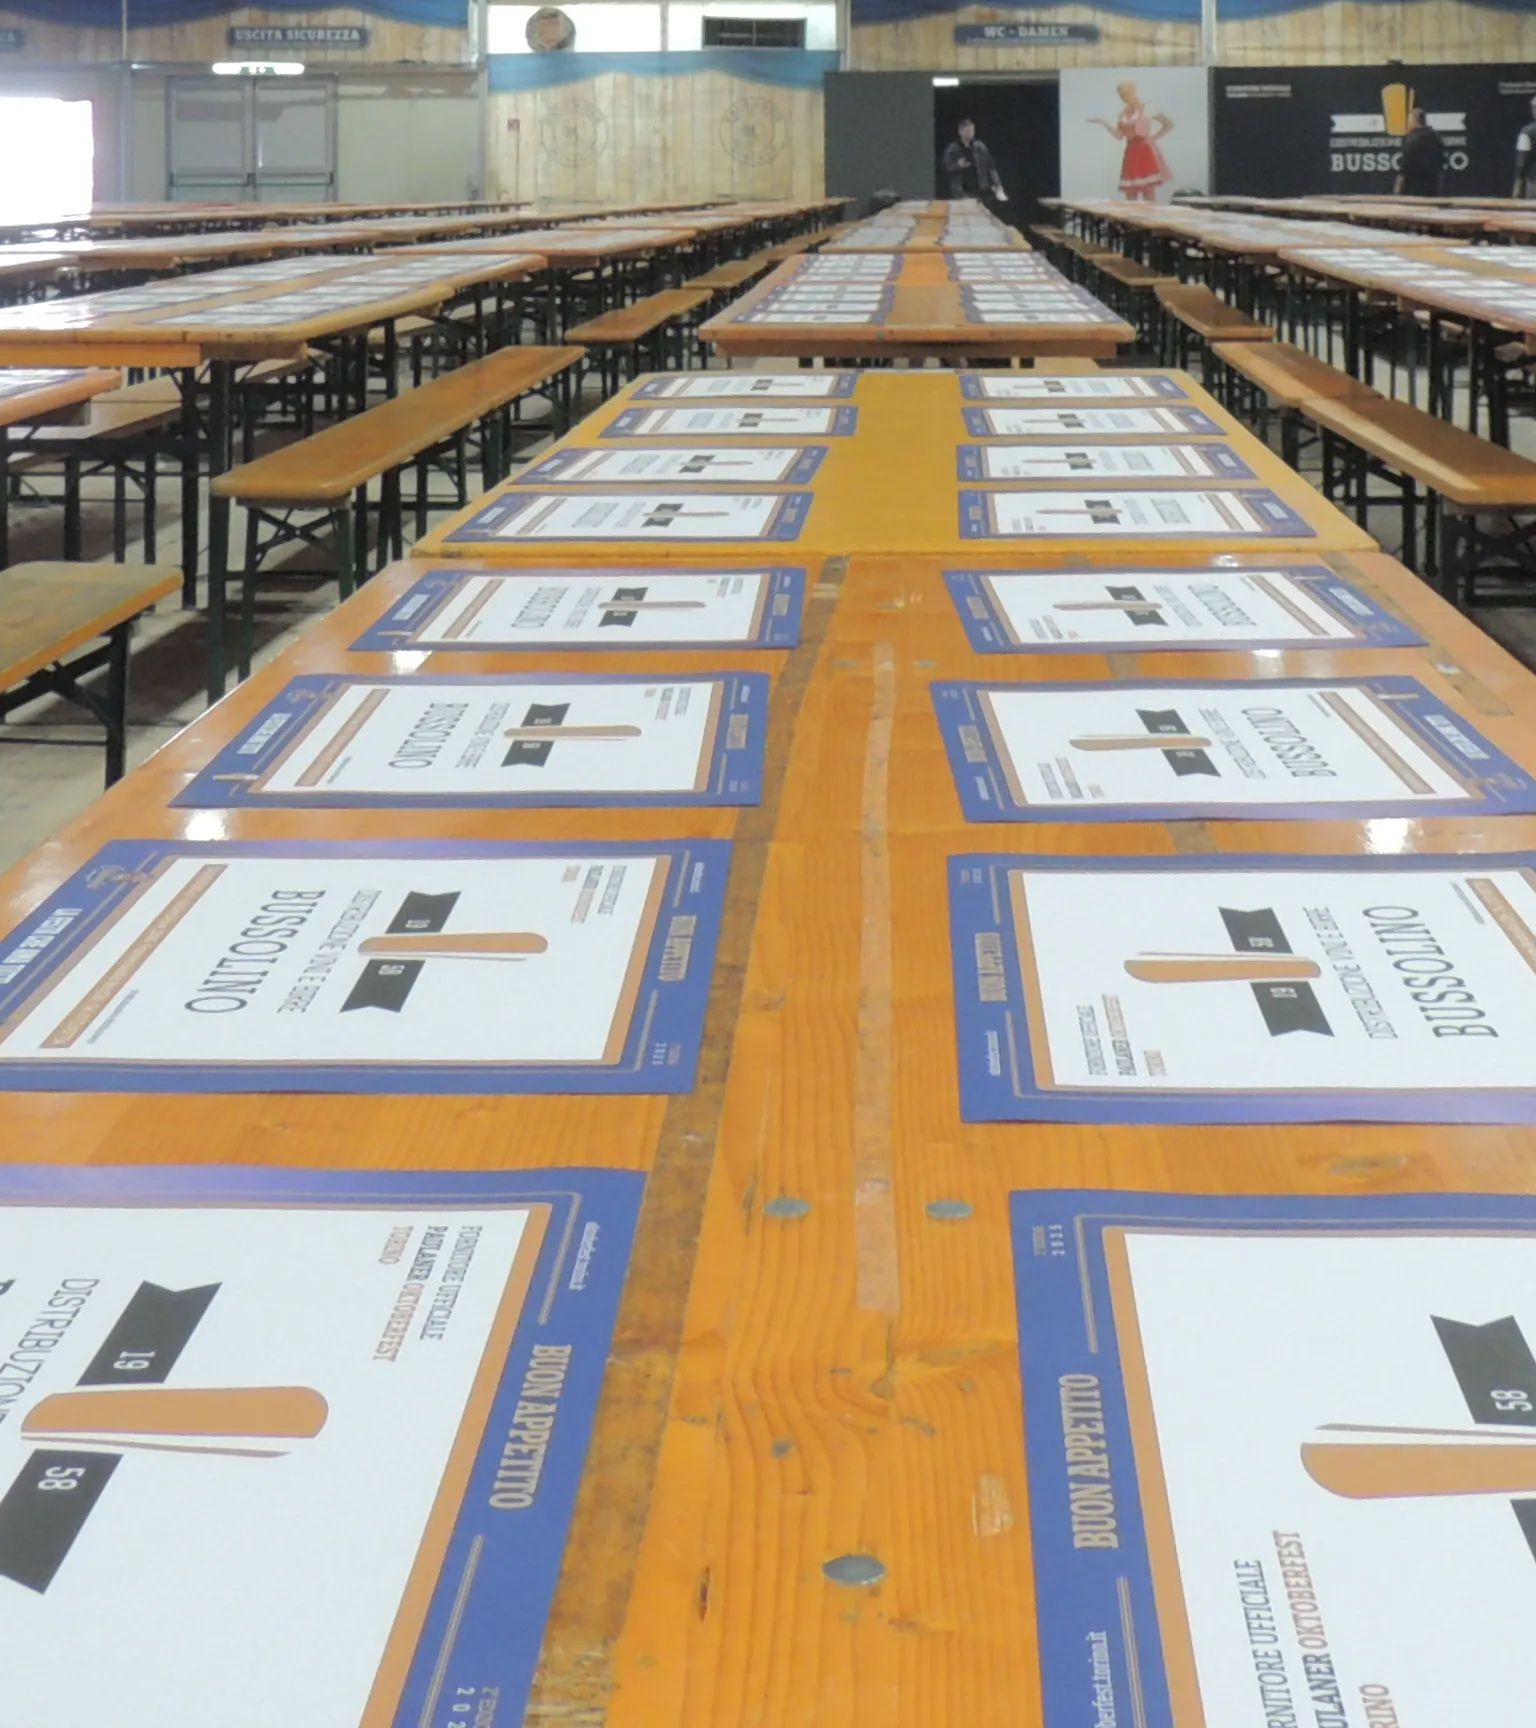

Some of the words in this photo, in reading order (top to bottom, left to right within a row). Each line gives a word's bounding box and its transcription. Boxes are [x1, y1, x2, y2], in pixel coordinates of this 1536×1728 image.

[235, 29, 283, 40] USCITA
[286, 29, 360, 40] SICUREZZA
[176, 890, 328, 1013] BUSSOLINO
[1357, 905, 1503, 1037] BUSSOLINO
[374, 1225, 415, 1264] TORINO
[404, 1225, 450, 1280] PAULANER
[438, 1225, 484, 1282] FORNITORE
[369, 1282, 428, 1361] OKTOBERFEST
[416, 1285, 462, 1340] UFFICIALE
[108, 1350, 158, 1369] 19
[516, 1344, 573, 1398] BUON
[483, 1400, 559, 1509] APPETITO
[1057, 1373, 1114, 1478] APPETITO
[27, 1466, 89, 1490] 58
[1067, 1482, 1123, 1549] BUON
[1231, 1559, 1283, 1644] UFFICIALE
[1269, 1530, 1335, 1649] OKTOBERFEST
[1084, 1631, 1120, 1728] berfest.torino.it
[1250, 1648, 1302, 1728] RNITORE
[1299, 1652, 1353, 1728] ULANER
[1357, 1683, 1402, 1728] RINO
